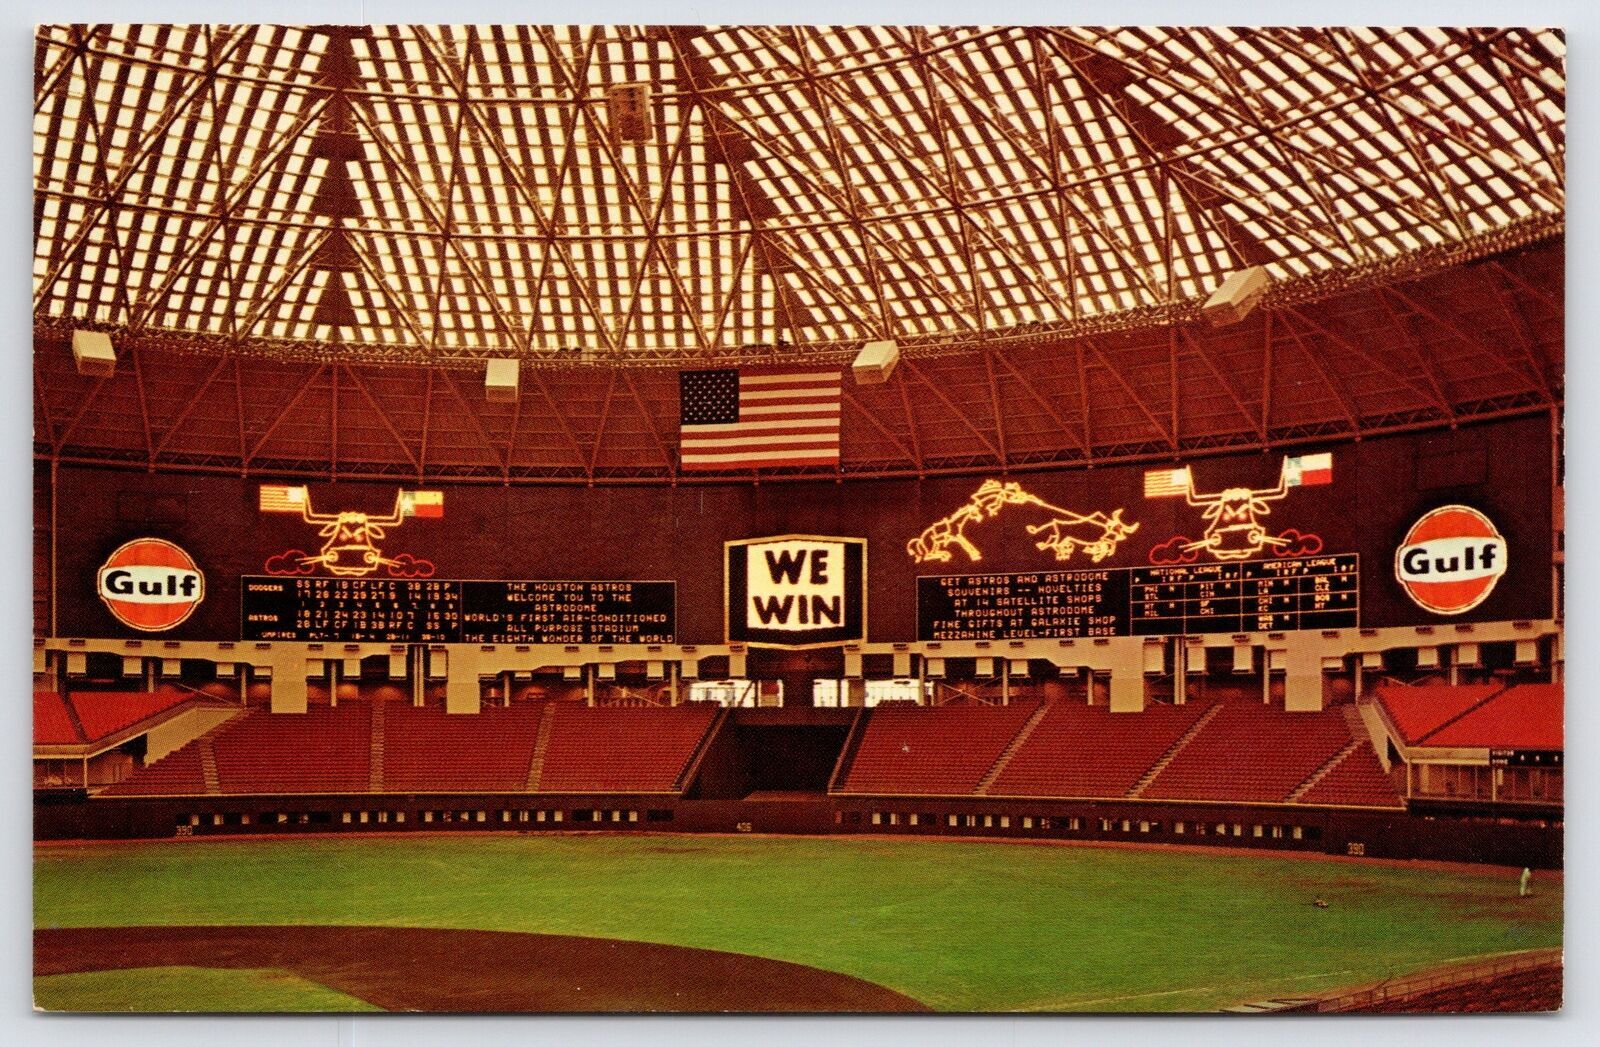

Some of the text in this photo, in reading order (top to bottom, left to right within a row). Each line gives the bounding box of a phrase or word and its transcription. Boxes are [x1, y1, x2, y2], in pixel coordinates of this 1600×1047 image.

[1263, 558, 1336, 569] AMERICAN LEAGUE
[1403, 544, 1497, 575] Gulf
[764, 549, 829, 585] WE
[1150, 566, 1222, 576] NATIONAL LEAGUE
[106, 570, 197, 596] Gulf
[940, 572, 1108, 586] GET ASTROS AND ASTRODOME
[296, 580, 310, 588] SS
[352, 581, 366, 589] CF
[408, 582, 421, 590] 3B
[426, 582, 440, 590] 2B
[507, 583, 632, 592] THE HOUSTON ASTROS
[948, 587, 1010, 596] SOUVENIRS
[1038, 583, 1102, 593] NOVELTIES
[371, 592, 385, 600] 27
[507, 594, 555, 602] WELCOME
[564, 594, 584, 602] YOU
[592, 594, 604, 602] TO
[954, 598, 967, 607] AT
[997, 596, 1059, 606] SATELLITE
[1067, 594, 1102, 603] SHOPS
[535, 604, 597, 612] ASTRODOME
[752, 594, 840, 624] WIN
[955, 606, 1094, 617] THROUGHOUT ASTRODOME
[352, 611, 366, 619] 23
[390, 612, 403, 620] 10
[464, 614, 667, 622] WORLD'S FIRST AIR-CONDITIONED
[335, 620, 348, 628] CF
[371, 621, 384, 629] 3B
[407, 622, 414, 630] C
[933, 620, 960, 628] FINE
[968, 619, 1003, 628] GIFTS
[1031, 617, 1080, 627] GALAXIE
[1088, 616, 1116, 625] SHOP
[507, 624, 639, 633] ALL PURPOSE STADIUM
[933, 627, 1116, 639] MEZZANINE LEVEL-FIRST BASE
[465, 634, 673, 643] THE EIGHTH WONDER OF THE WORLD
